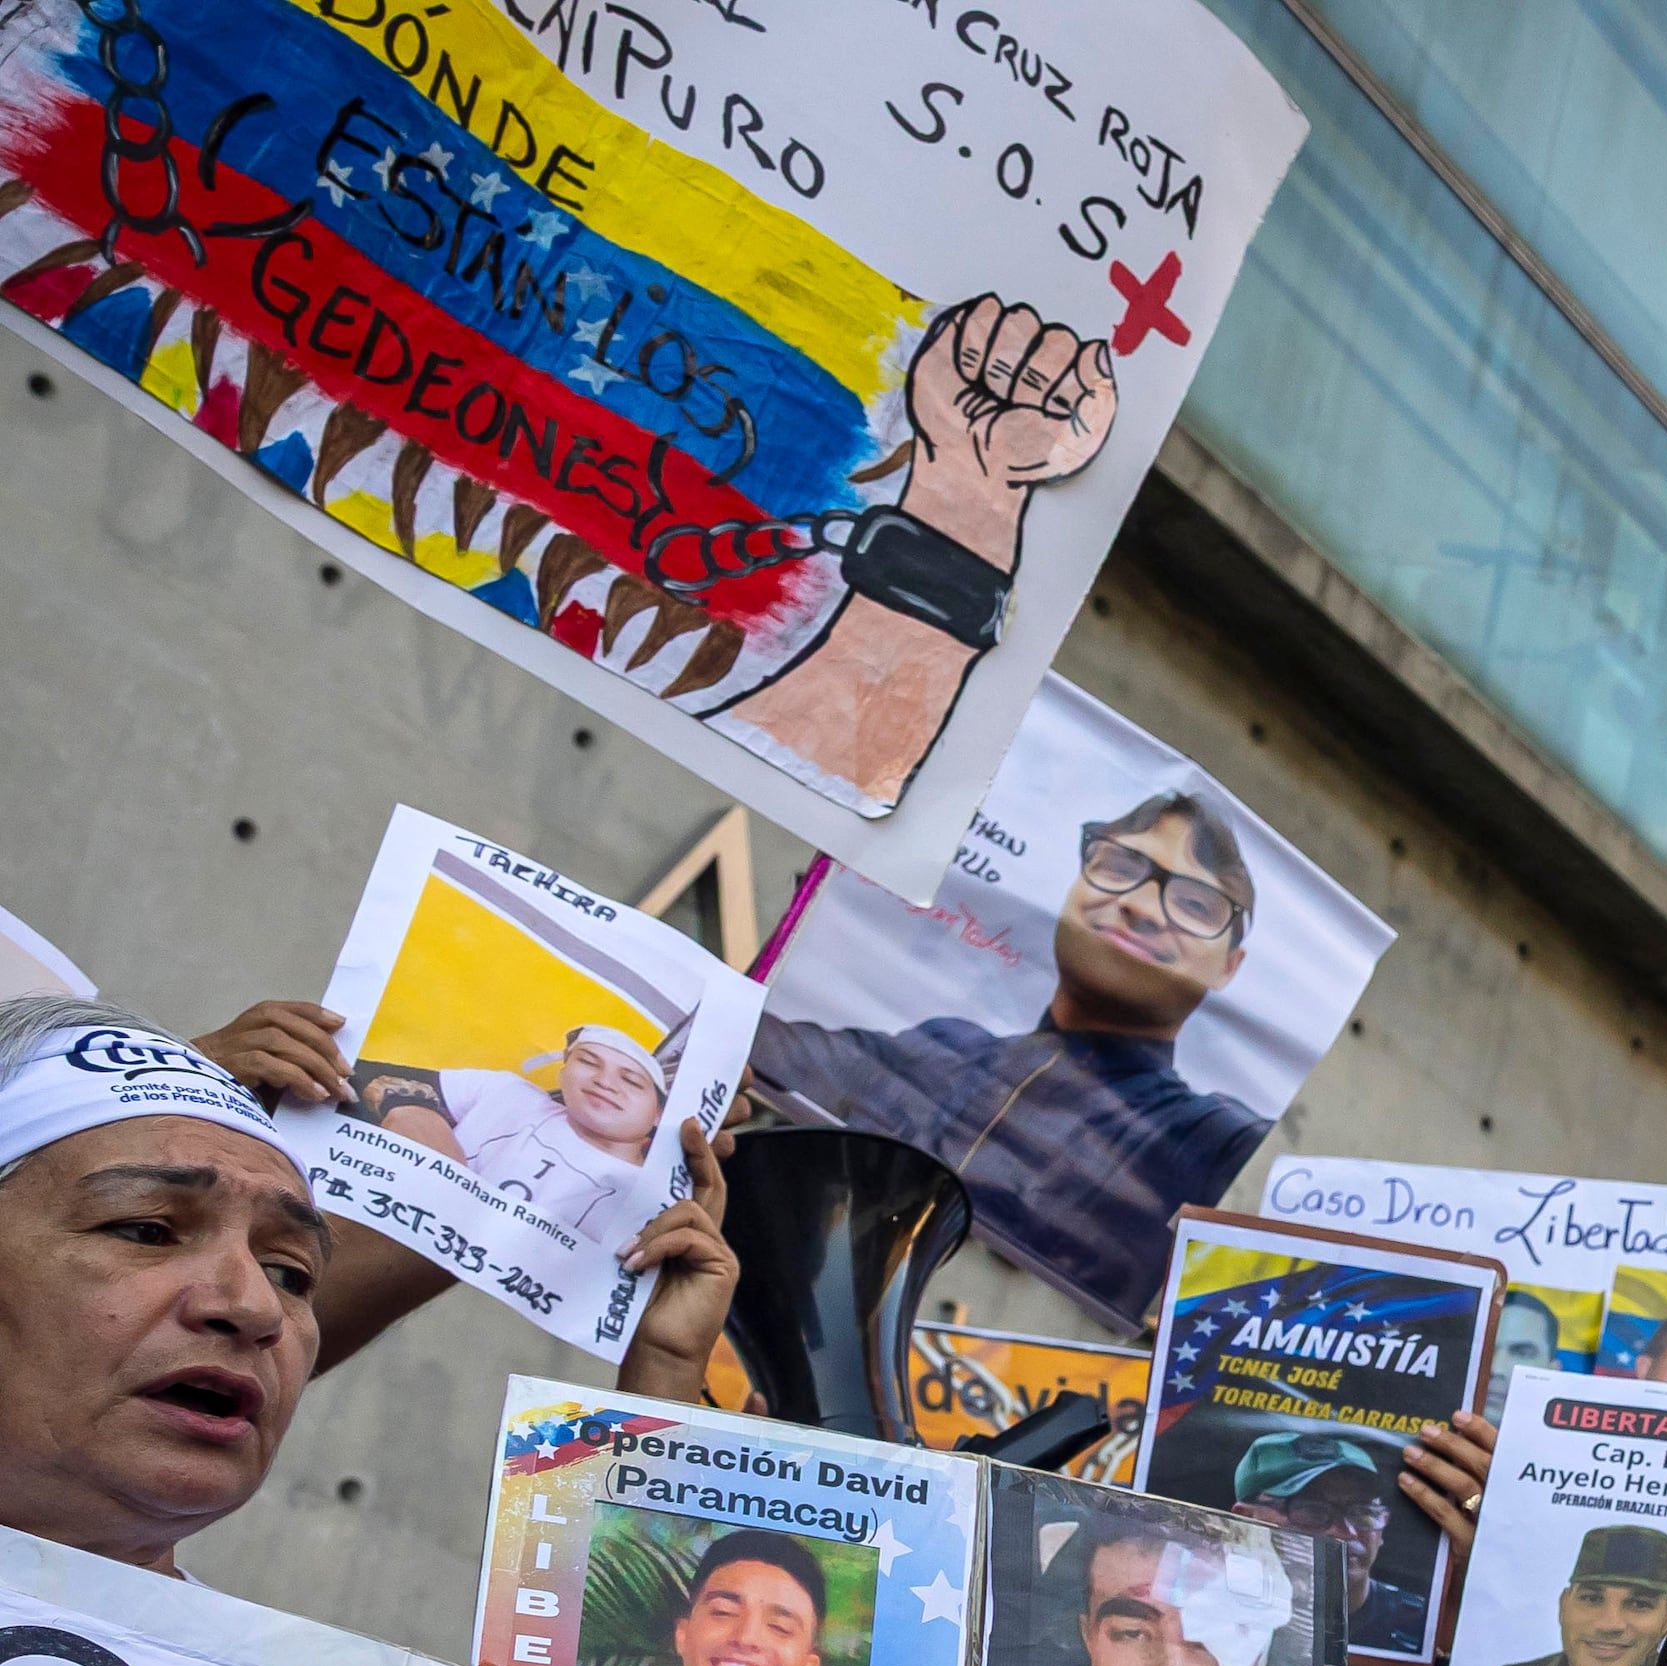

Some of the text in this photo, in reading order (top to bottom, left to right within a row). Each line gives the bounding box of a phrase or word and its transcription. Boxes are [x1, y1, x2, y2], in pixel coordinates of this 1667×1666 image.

[956, 10, 1204, 240] CRUZ ROJA
[327, 1147, 397, 1185] Vargas
[335, 1120, 428, 1168] Anthony
[428, 1157, 509, 1213] Abraham
[1269, 1167, 1366, 1219] Caso
[1372, 1176, 1476, 1232] Dron
[1217, 1354, 1344, 1392] TCNEL JOSÉ
[1232, 1315, 1441, 1379] AMNISTÍA
[1212, 1384, 1336, 1424] TORREALBA
[578, 1418, 930, 1506] Operación David
[1518, 1462, 1616, 1490] Anyelo
[1592, 1442, 1652, 1470] Cap.
[603, 1462, 879, 1544] (Paramacay)
